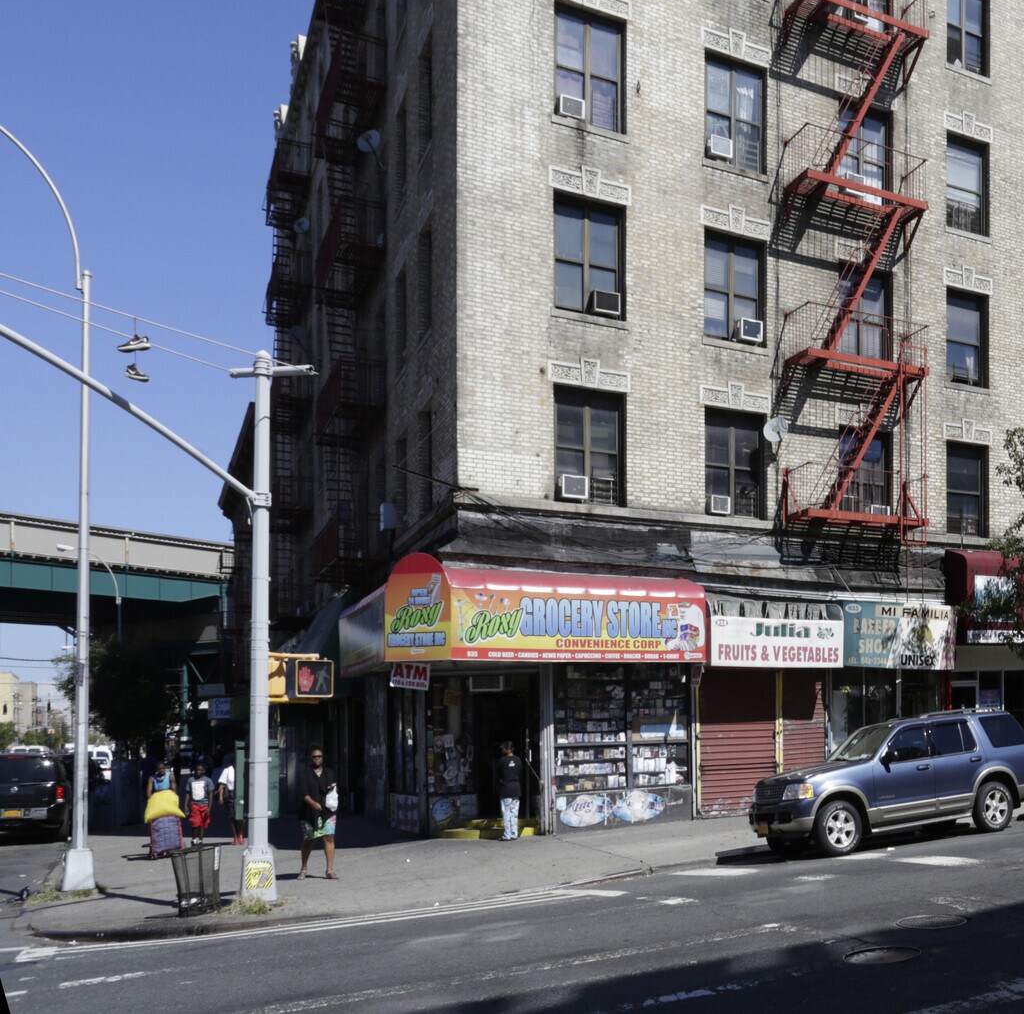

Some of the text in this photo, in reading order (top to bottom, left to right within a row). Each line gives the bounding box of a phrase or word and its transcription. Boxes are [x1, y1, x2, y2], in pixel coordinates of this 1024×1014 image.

[391, 601, 443, 633] Roxy
[465, 607, 524, 643] Roxy
[520, 596, 604, 638] GROCERY
[607, 599, 661, 639] STORE
[881, 606, 949, 619] MI FAMILIA
[750, 622, 811, 638] Julia
[555, 638, 662, 649] CONVENIENCE CORP
[718, 644, 757, 661] FRUITS
[760, 645, 769, 662] &
[773, 646, 839, 663] VEGETABLES
[901, 653, 936, 666] UNISEX
[393, 664, 428, 681] ATM
[574, 801, 593, 811] Lite
